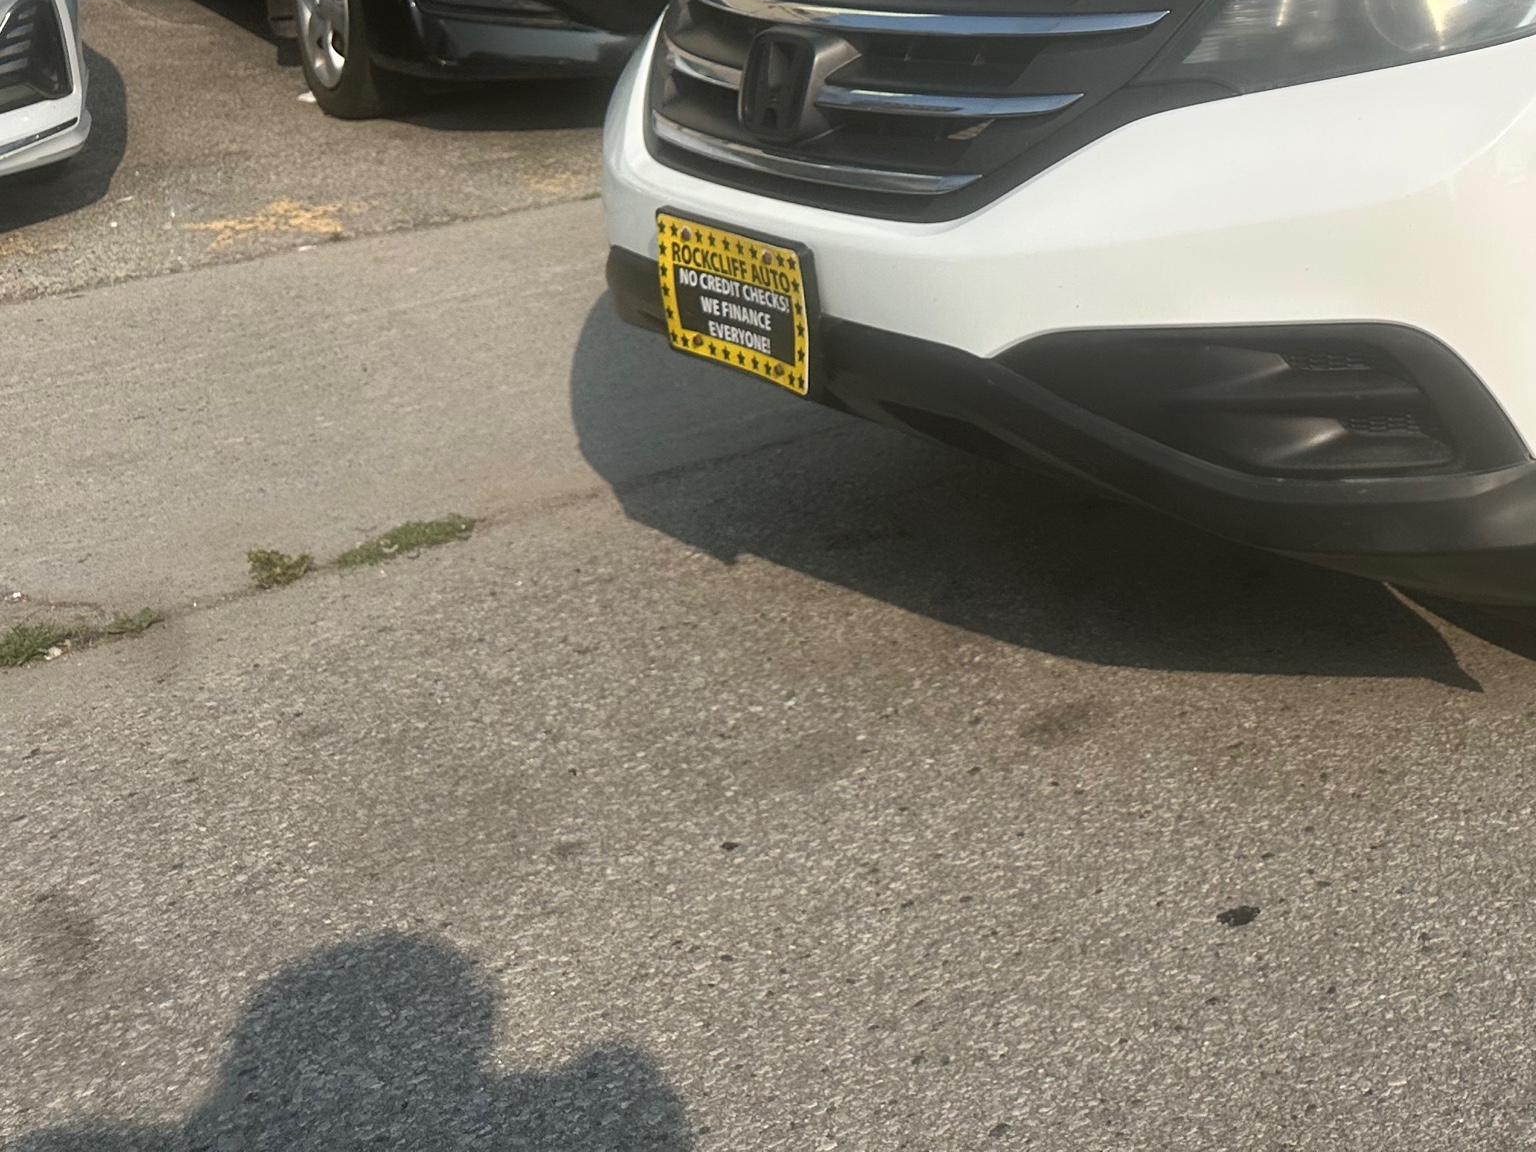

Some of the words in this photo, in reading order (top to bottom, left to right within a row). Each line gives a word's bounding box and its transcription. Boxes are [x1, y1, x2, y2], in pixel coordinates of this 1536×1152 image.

[672, 242, 748, 280] ROCKCLIFF
[751, 263, 792, 293] AUTO
[679, 268, 698, 287] NO
[700, 273, 740, 298] CREDIT
[742, 288, 790, 313] CHECKS!
[700, 296, 720, 316] WE
[722, 302, 771, 331] FINANCE
[709, 320, 771, 354] EVERYONE!
